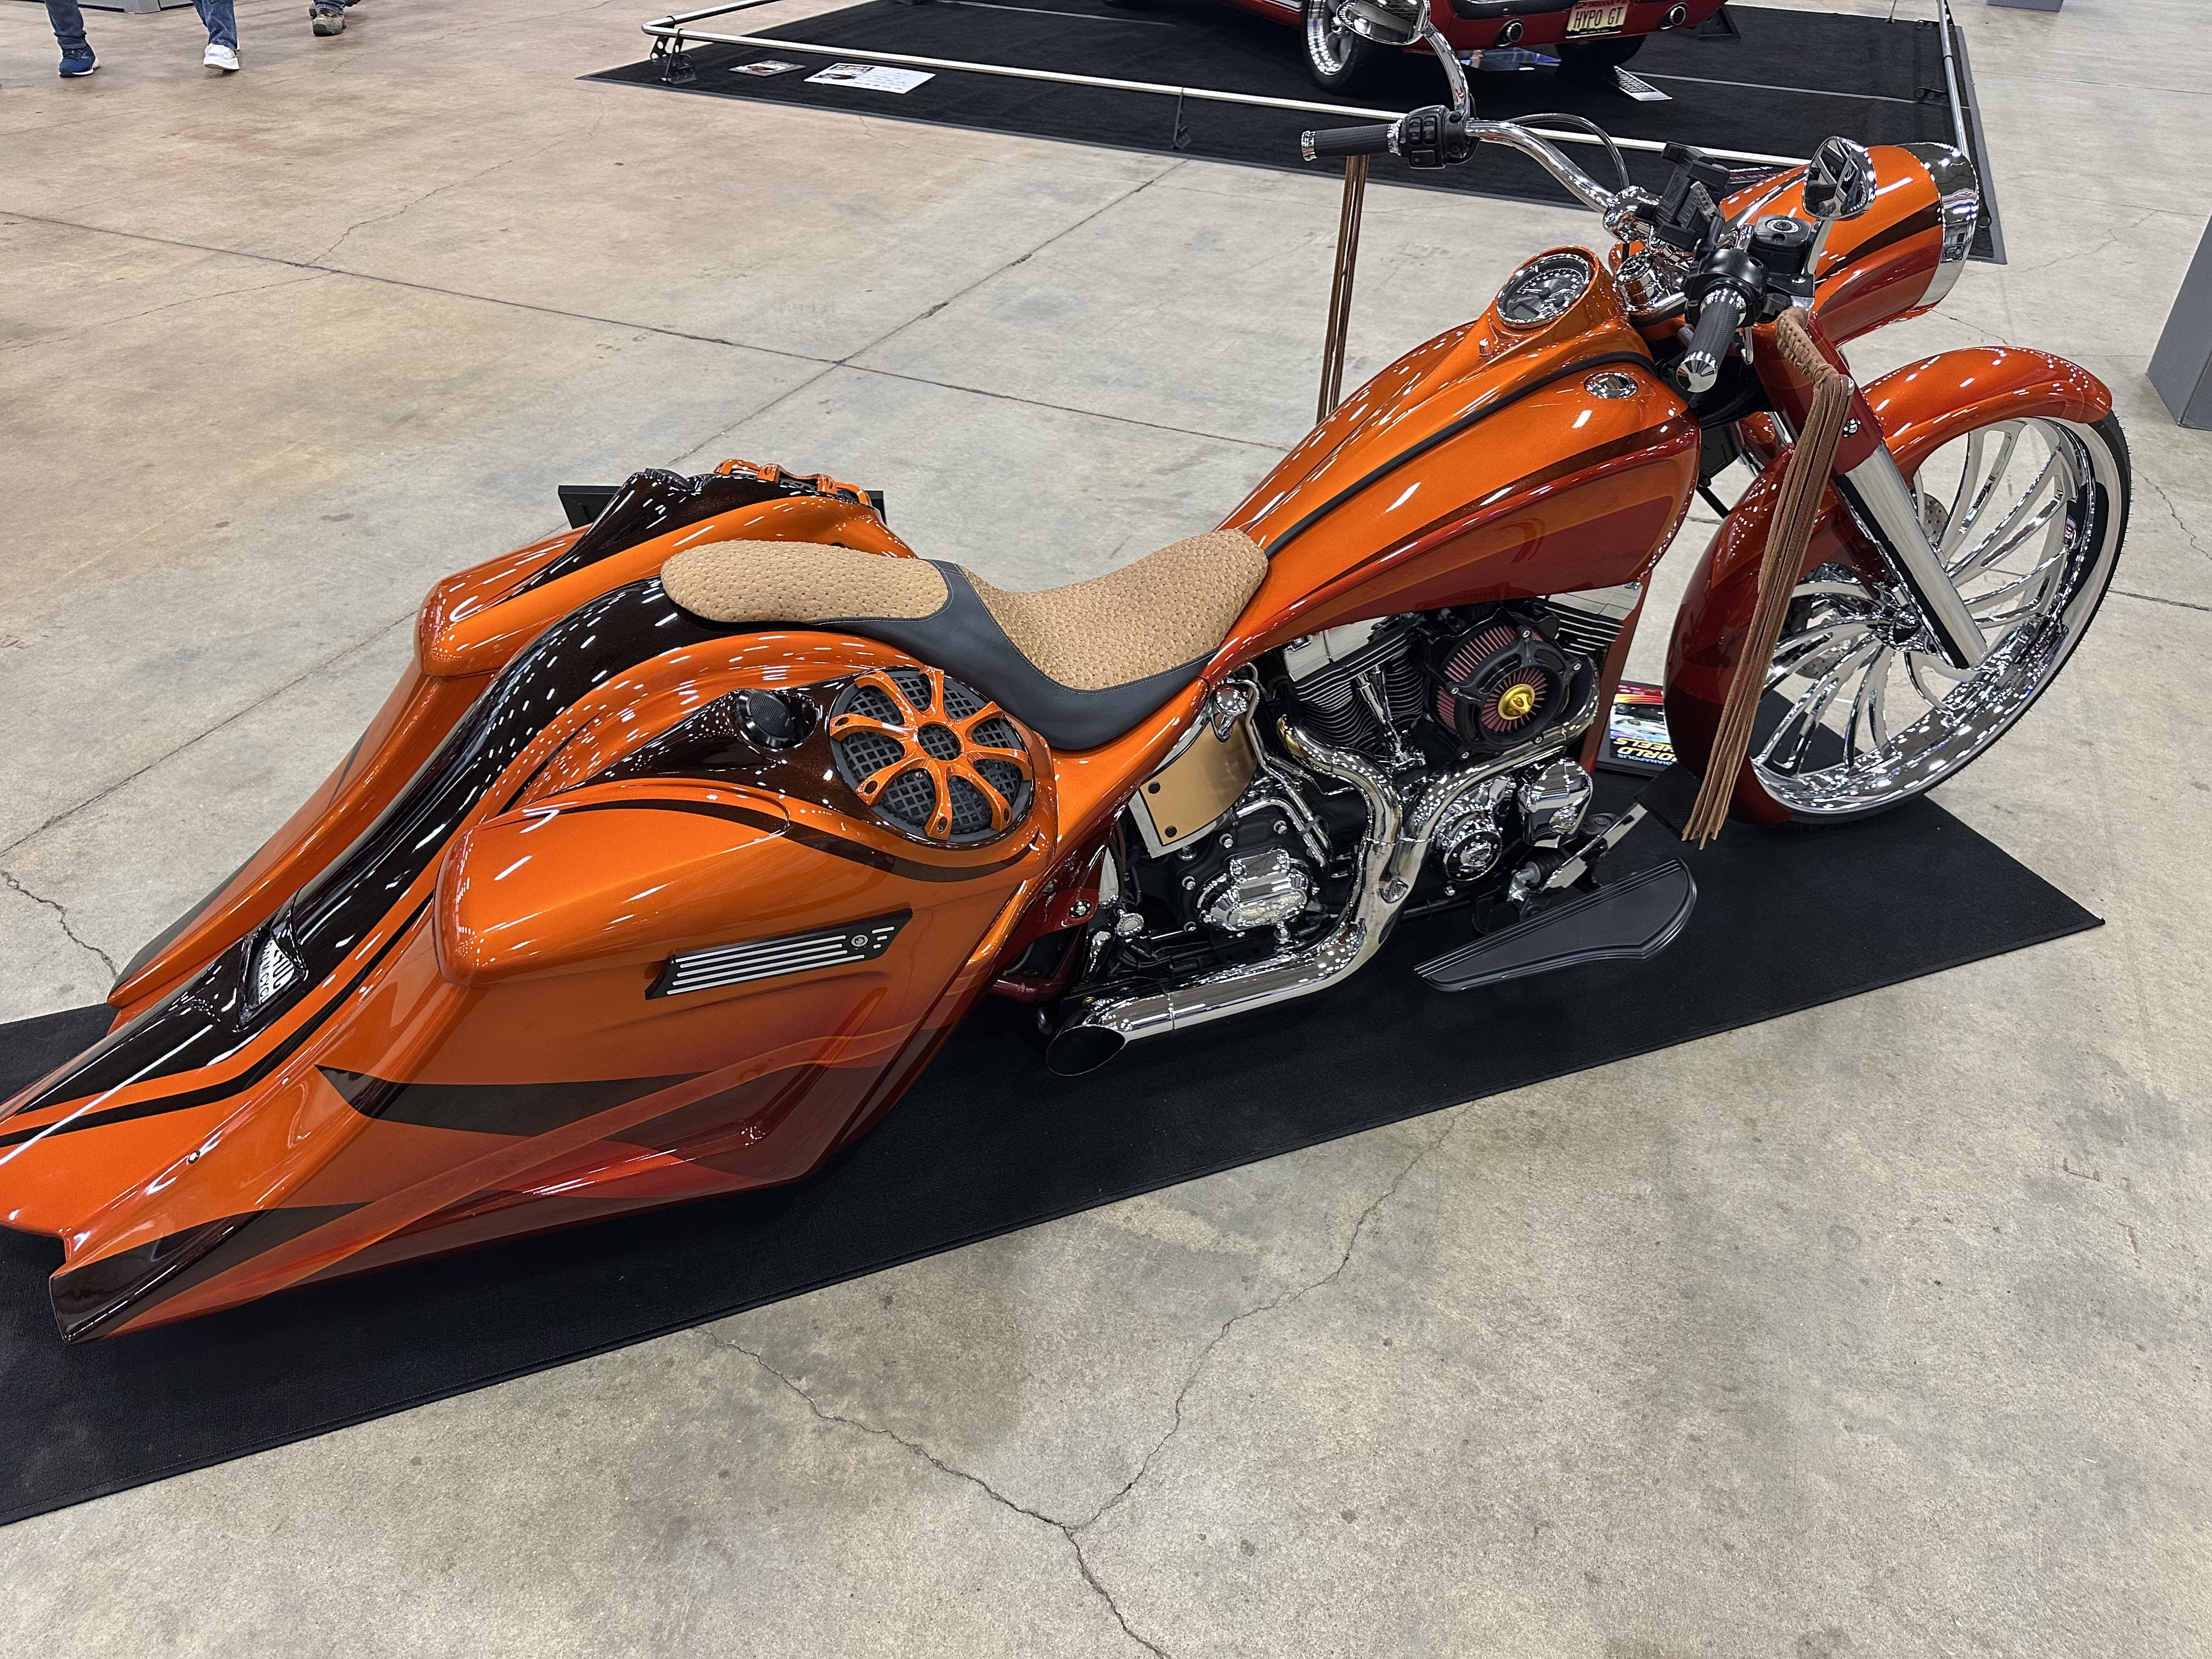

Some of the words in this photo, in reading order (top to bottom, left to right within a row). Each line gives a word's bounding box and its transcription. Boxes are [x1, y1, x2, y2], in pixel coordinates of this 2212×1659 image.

[1573, 9, 1602, 29] HYPO
[1607, 7, 1624, 25] GT
[1613, 737, 1674, 753] HEELS
[1617, 753, 1673, 766] DIANAPOLIS
[259, 972, 269, 1004] CYCL
